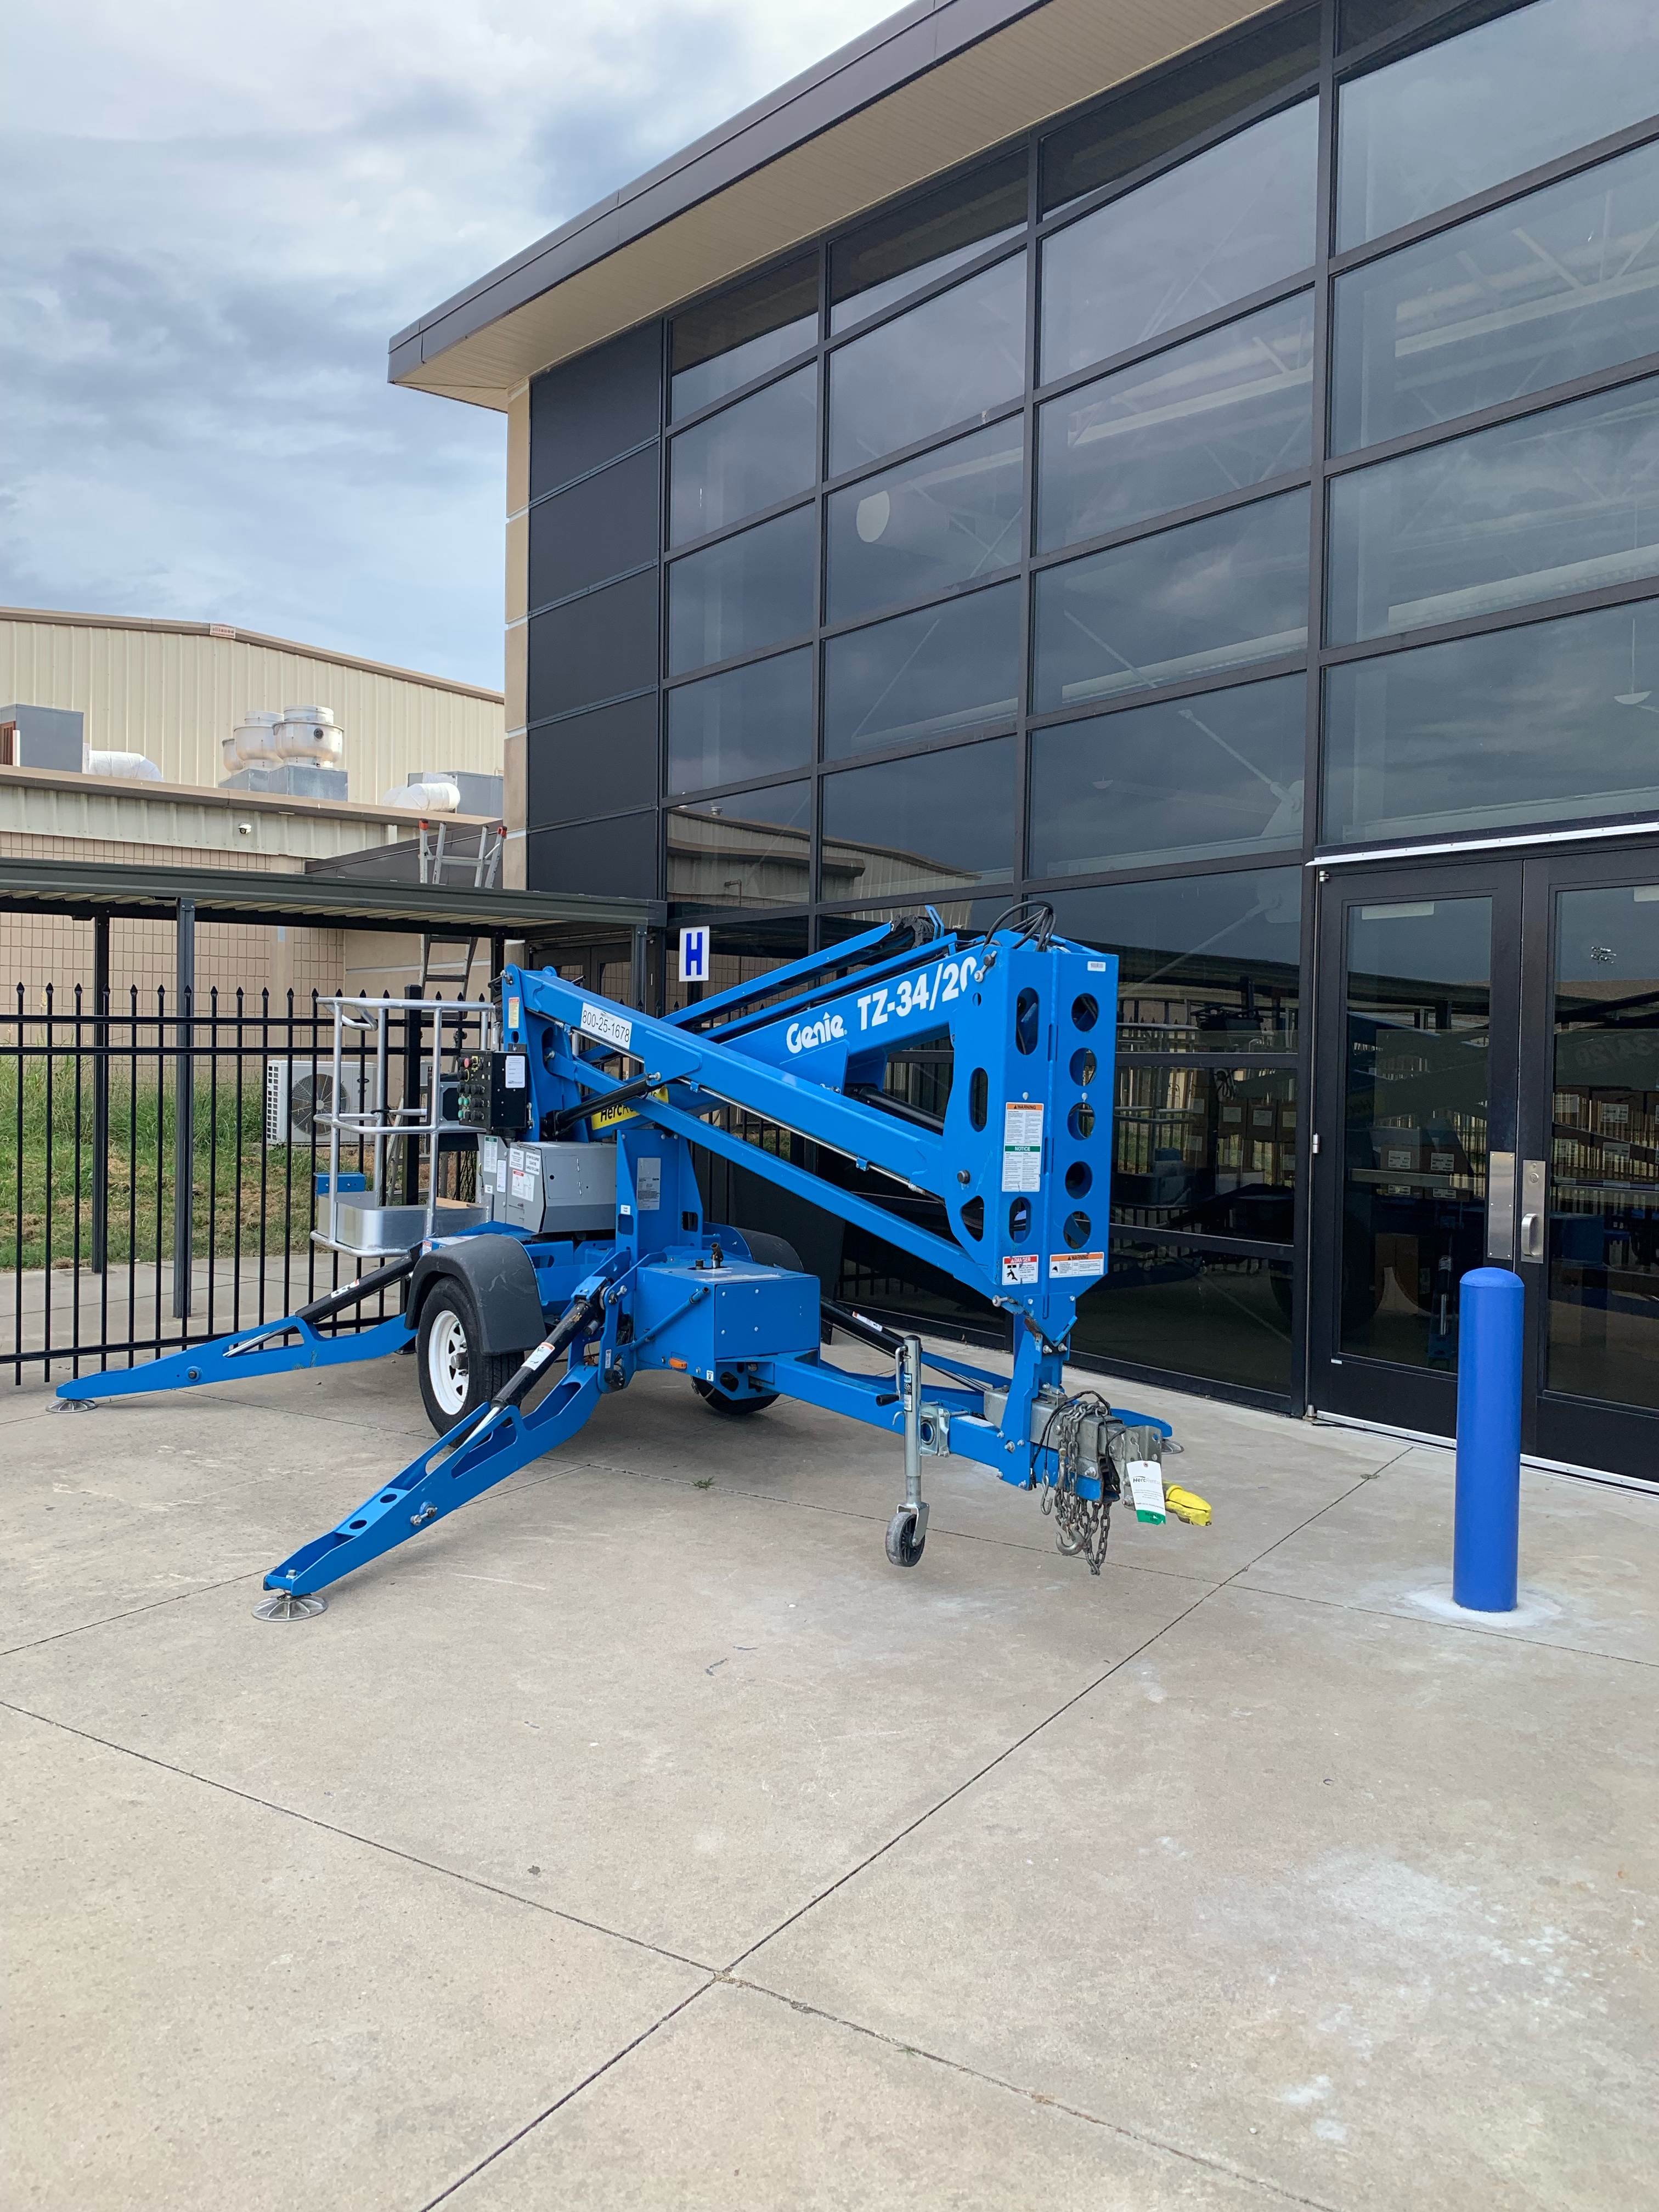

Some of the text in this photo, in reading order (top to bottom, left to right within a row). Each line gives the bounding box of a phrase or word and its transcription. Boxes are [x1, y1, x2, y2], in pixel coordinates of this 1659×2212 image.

[685, 932, 703, 976] H
[857, 956, 977, 1031] TZ-34/20
[582, 1009, 630, 1042] 800-25-1678
[786, 1012, 845, 1053] Genie
